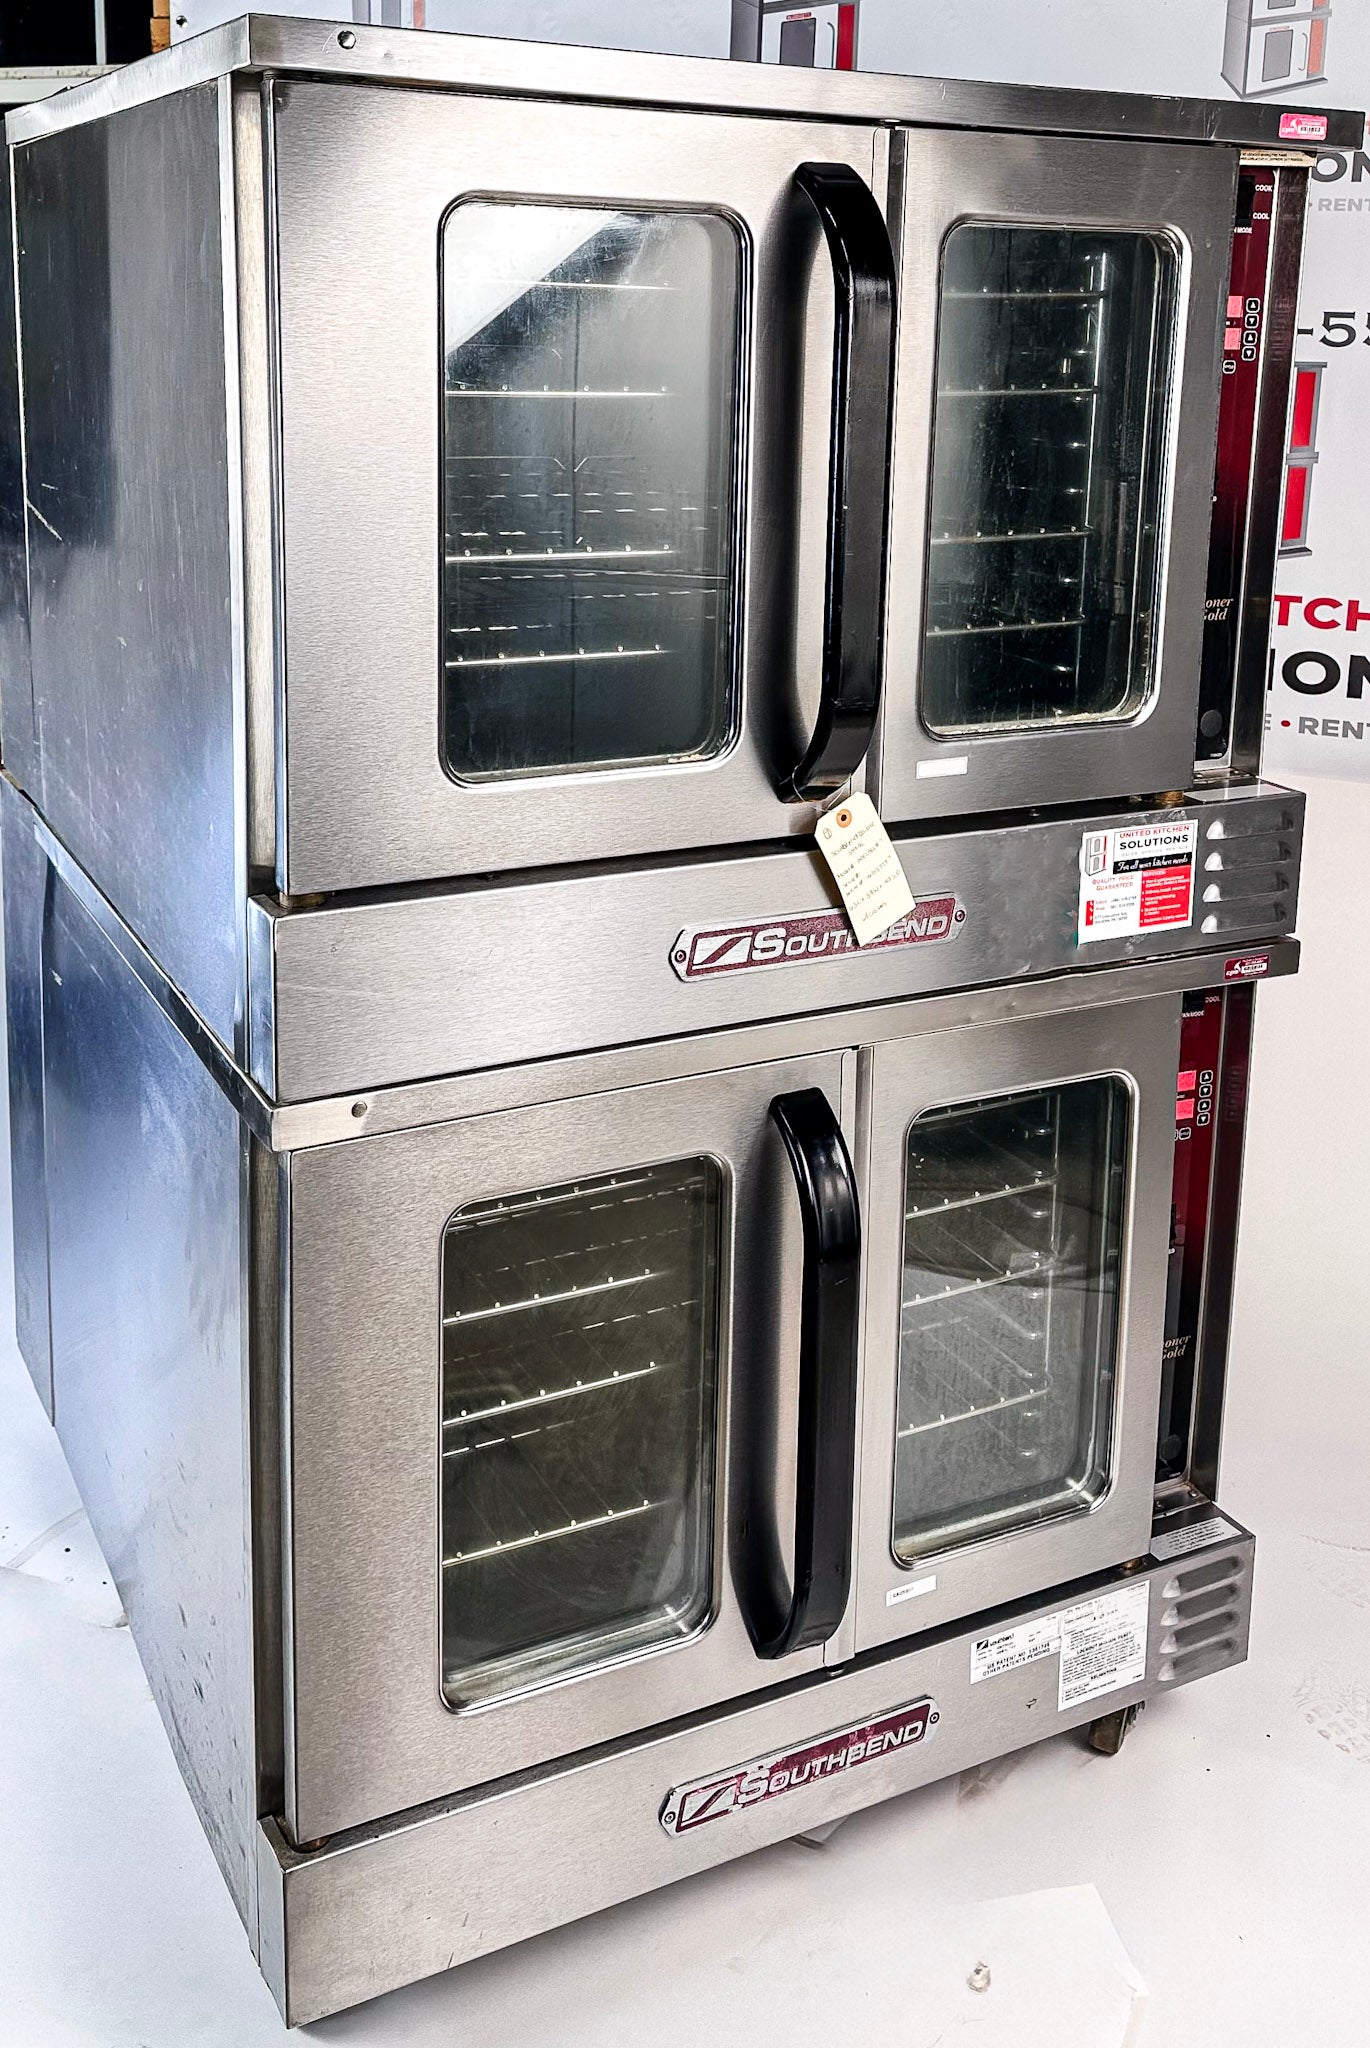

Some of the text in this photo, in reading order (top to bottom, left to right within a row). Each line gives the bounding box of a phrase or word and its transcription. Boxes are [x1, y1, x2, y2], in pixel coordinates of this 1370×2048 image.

[1252, 212, 1270, 220] COOL
[1298, 716, 1370, 740] REN
[1119, 825, 1190, 839] UNITED KITCHEN
[1119, 834, 1189, 850] SOLUTIONS
[737, 1720, 924, 1804] SOUTHBEND
